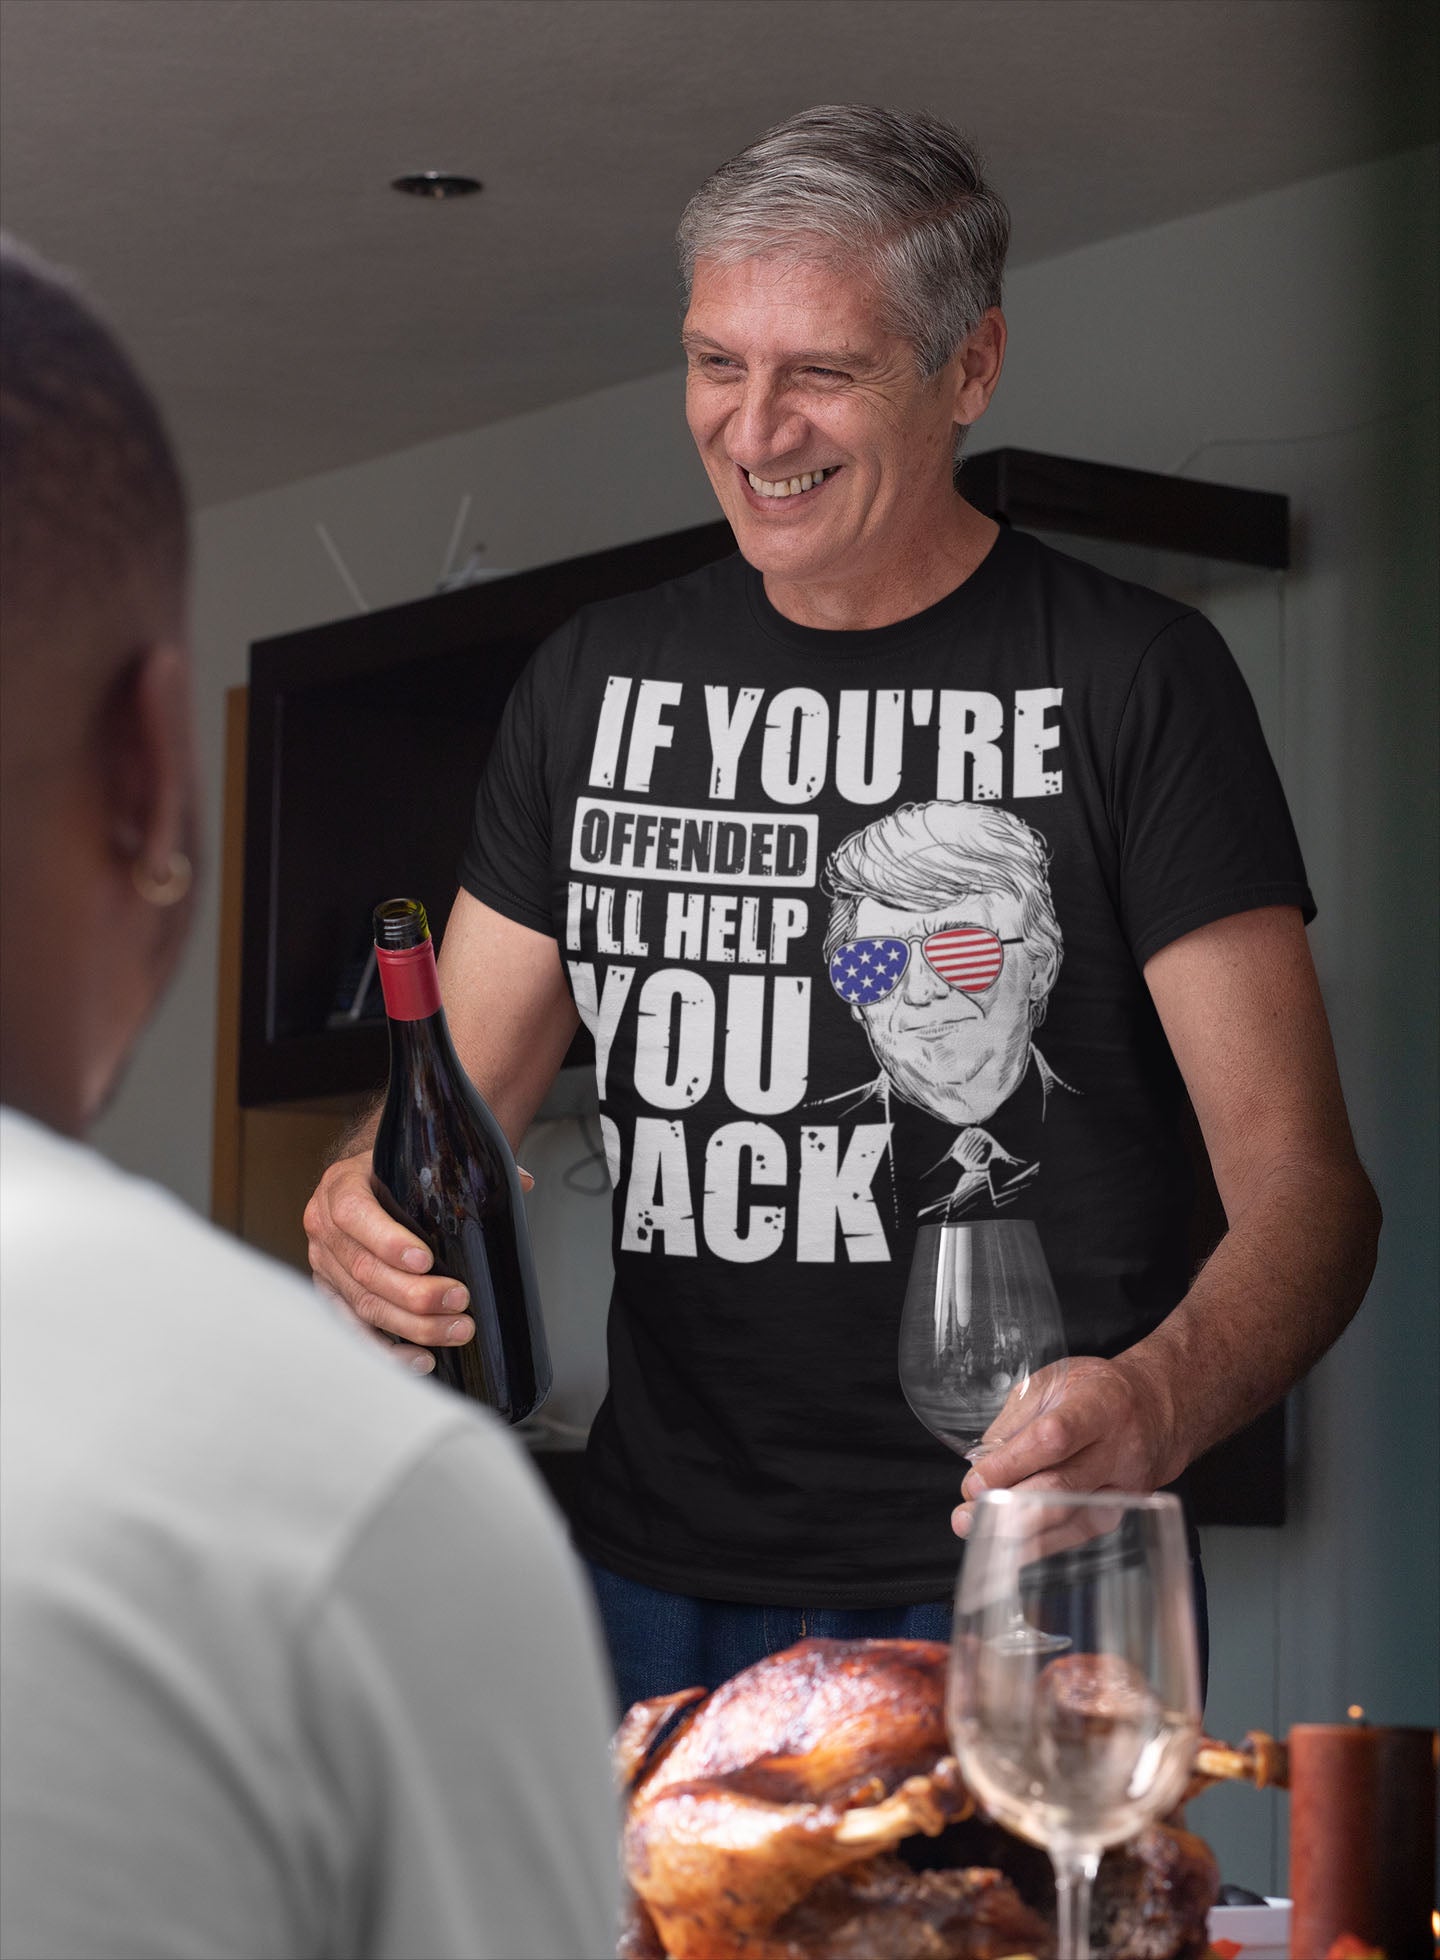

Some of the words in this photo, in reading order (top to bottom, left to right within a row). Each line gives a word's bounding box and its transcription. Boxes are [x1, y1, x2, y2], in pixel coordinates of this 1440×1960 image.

[588, 676, 683, 792] IF
[704, 685, 1064, 805] YOU'RE
[579, 808, 809, 877] OFFENDED
[566, 882, 648, 957] I'LL
[664, 892, 808, 964] HELP
[567, 960, 811, 1115] YOU
[600, 1114, 894, 1263] ACK
